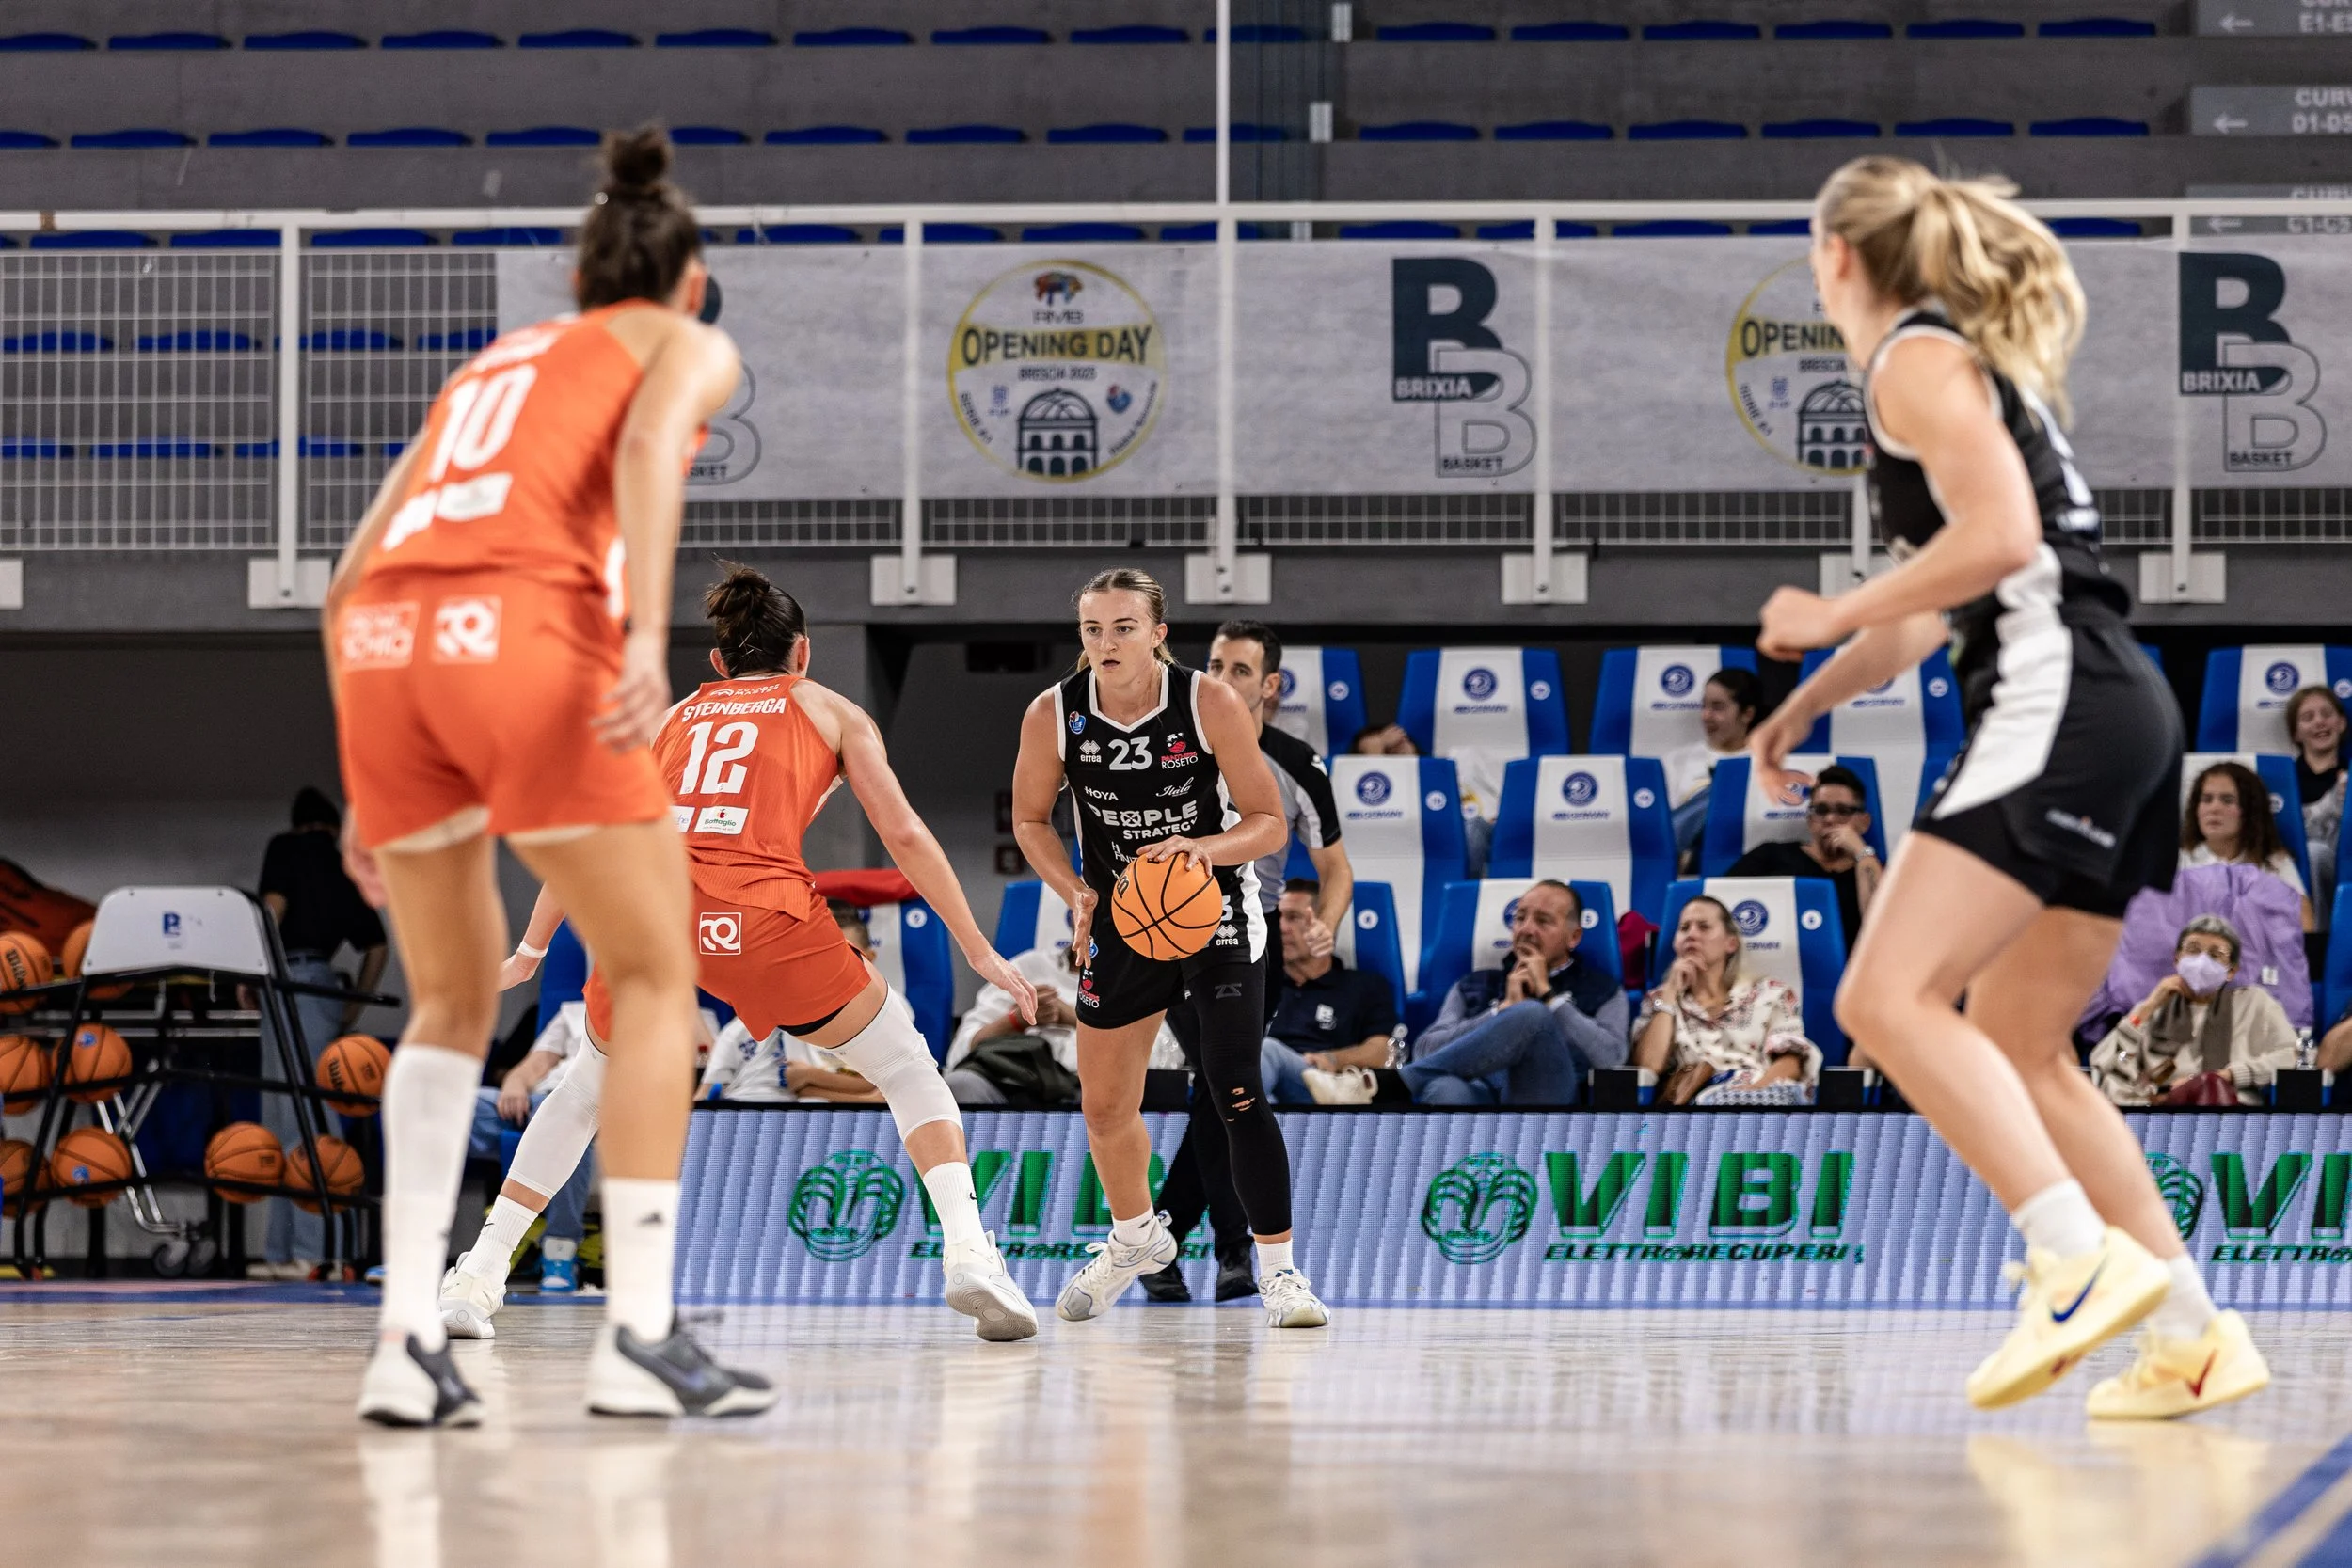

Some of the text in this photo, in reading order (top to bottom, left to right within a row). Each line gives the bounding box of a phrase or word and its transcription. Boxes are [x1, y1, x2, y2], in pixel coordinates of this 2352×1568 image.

[962, 325, 1152, 365] OPENING DAY
[1742, 319, 1846, 358] OPENIN
[1395, 377, 1473, 399] BRIXIA
[2182, 372, 2262, 393] BRIXIA
[429, 363, 538, 483] 10
[1442, 457, 1504, 470] BASKET
[2230, 453, 2293, 467] BASKET
[689, 465, 728, 479] SKET
[682, 698, 787, 722] STEINBERGA
[679, 721, 759, 795] 12
[1107, 736, 1152, 770] 23
[1161, 755, 1199, 769] ROSETO
[1084, 786, 1119, 800] HOYA
[1087, 800, 1198, 827] PEOPLE
[1122, 817, 1198, 840] STRATEGY
[1544, 1150, 1855, 1239] VIBI
